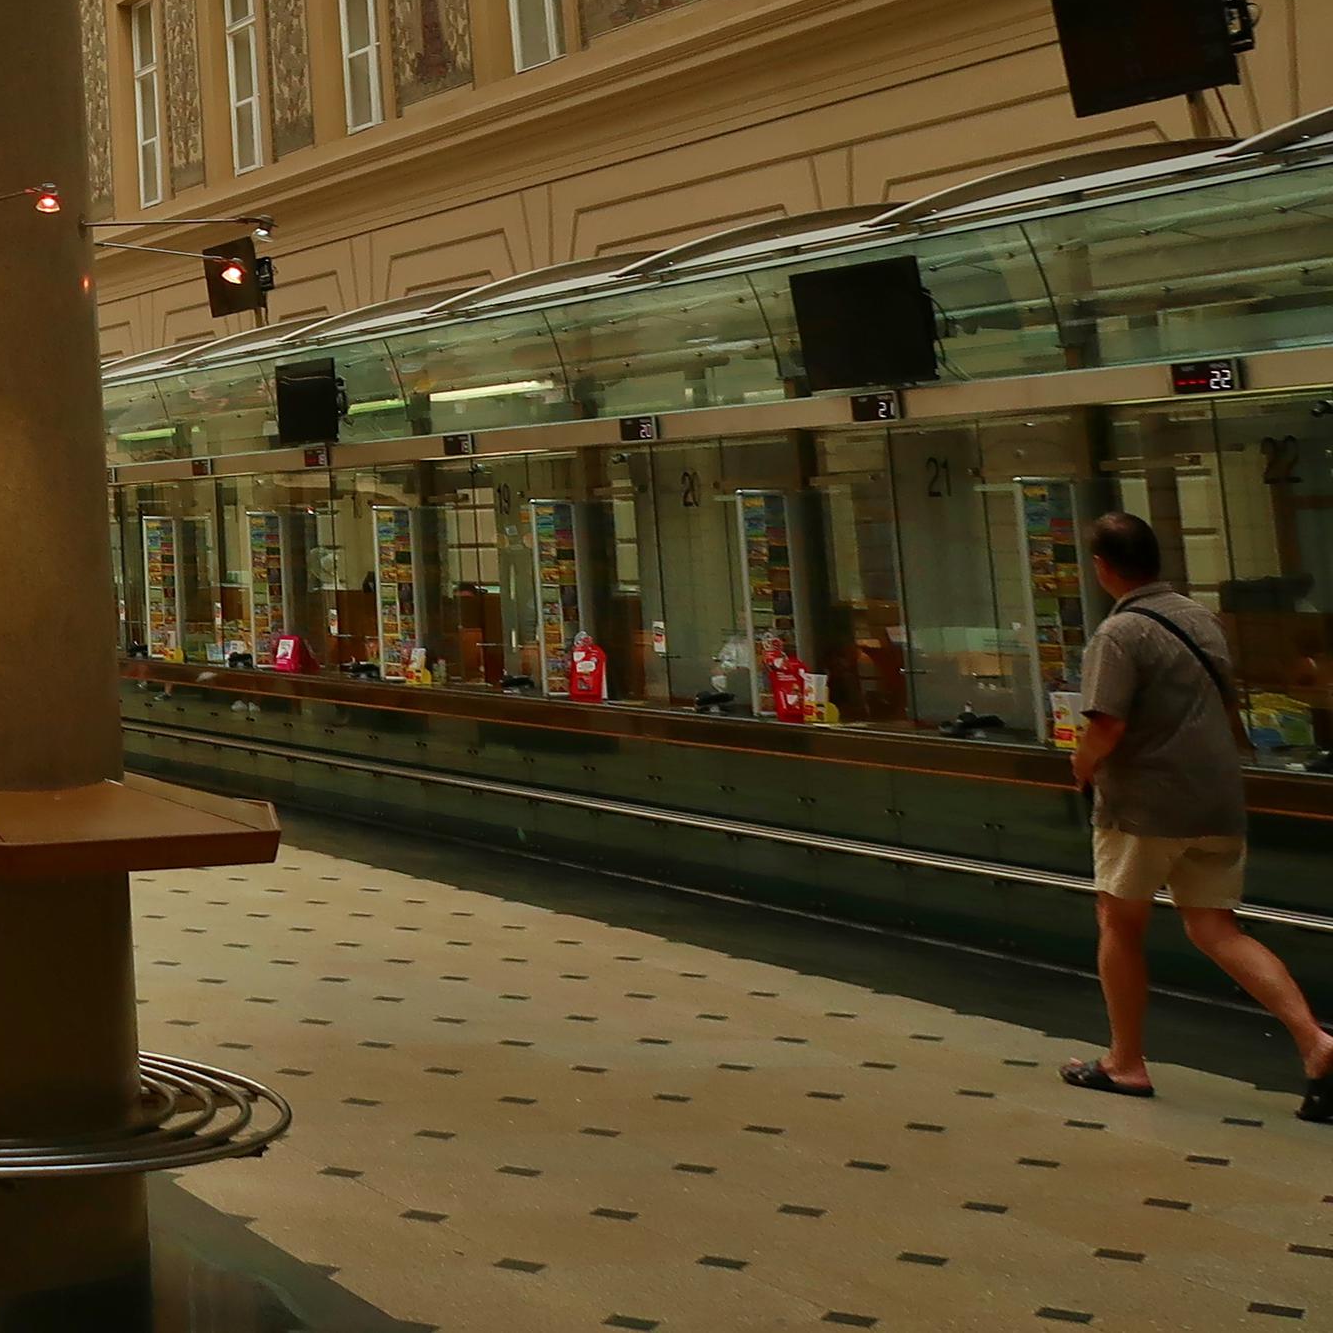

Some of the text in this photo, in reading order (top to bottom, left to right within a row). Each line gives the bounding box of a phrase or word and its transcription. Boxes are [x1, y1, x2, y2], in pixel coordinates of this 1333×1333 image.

[1210, 369, 1232, 390] 22
[878, 401, 895, 418] 21
[1261, 435, 1303, 485] 22
[925, 457, 952, 498] 21
